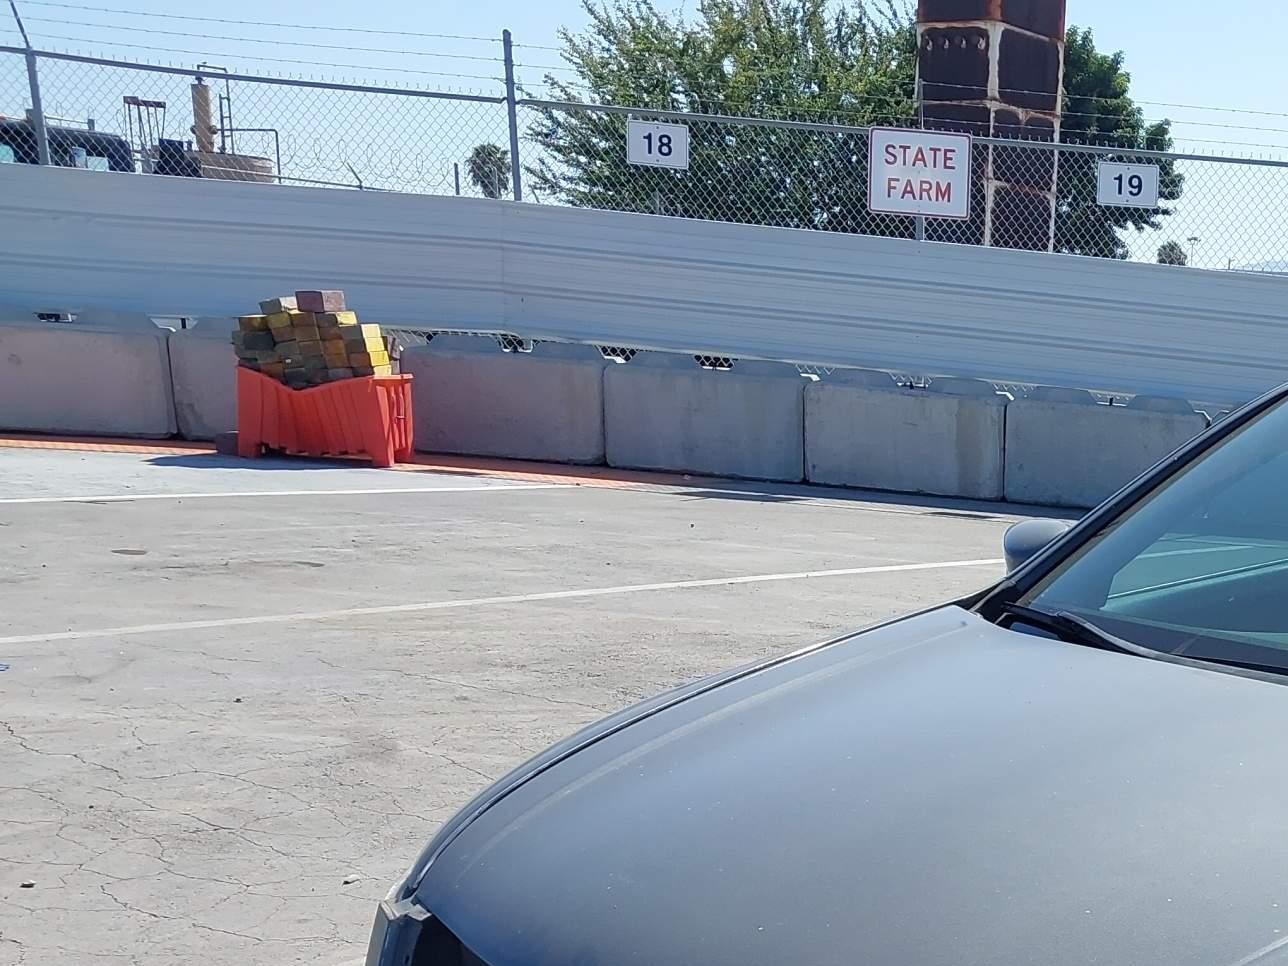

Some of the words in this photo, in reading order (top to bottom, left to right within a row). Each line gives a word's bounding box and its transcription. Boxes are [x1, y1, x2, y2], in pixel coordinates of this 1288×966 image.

[642, 132, 673, 157] 18
[884, 143, 957, 171] STATE
[886, 177, 952, 204] FARM
[1113, 173, 1143, 197] 19
